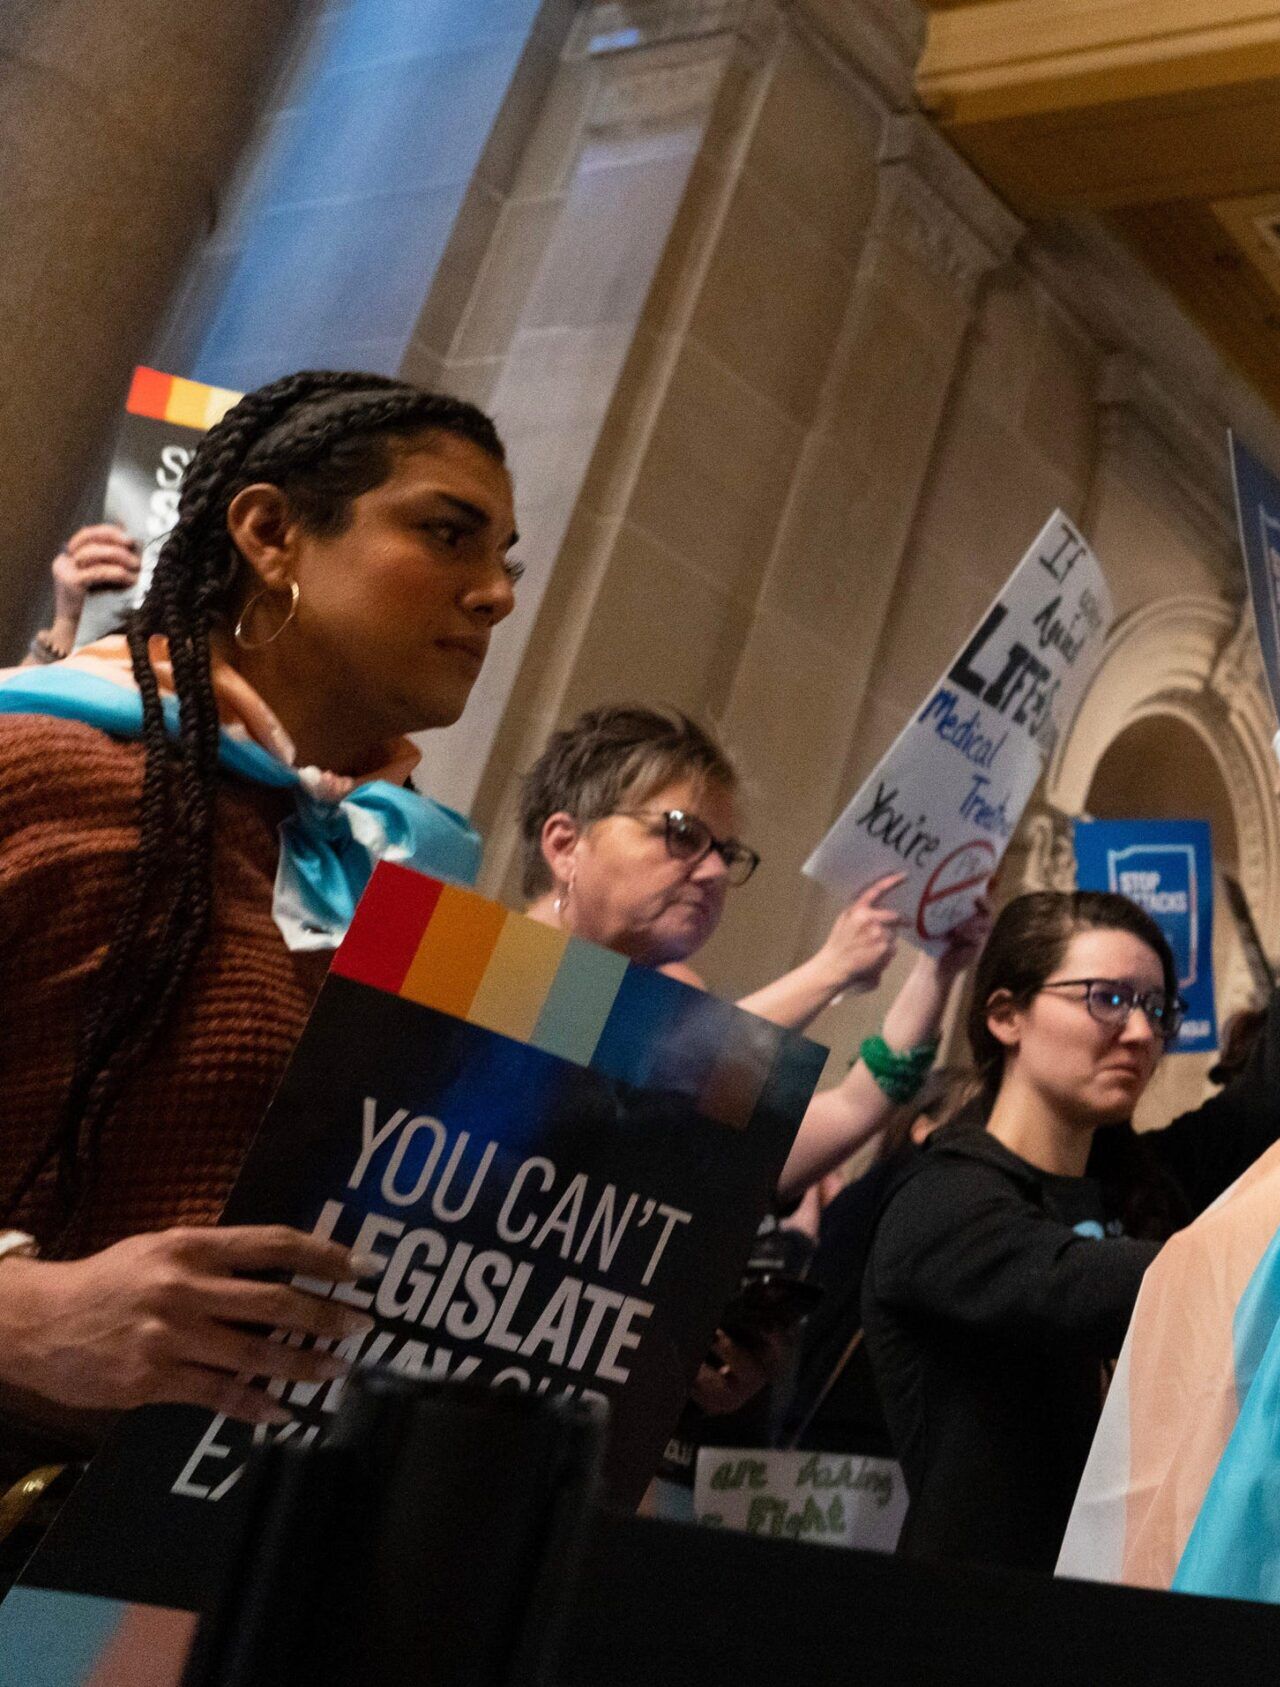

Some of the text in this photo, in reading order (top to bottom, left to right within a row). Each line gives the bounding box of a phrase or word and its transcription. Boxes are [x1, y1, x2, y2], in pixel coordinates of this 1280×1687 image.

[1039, 522, 1087, 585] If
[918, 686, 1009, 769] Medical
[856, 781, 941, 868] You're
[346, 1096, 694, 1288] YOU CAN'T
[290, 1199, 656, 1384] LEGISLATE
